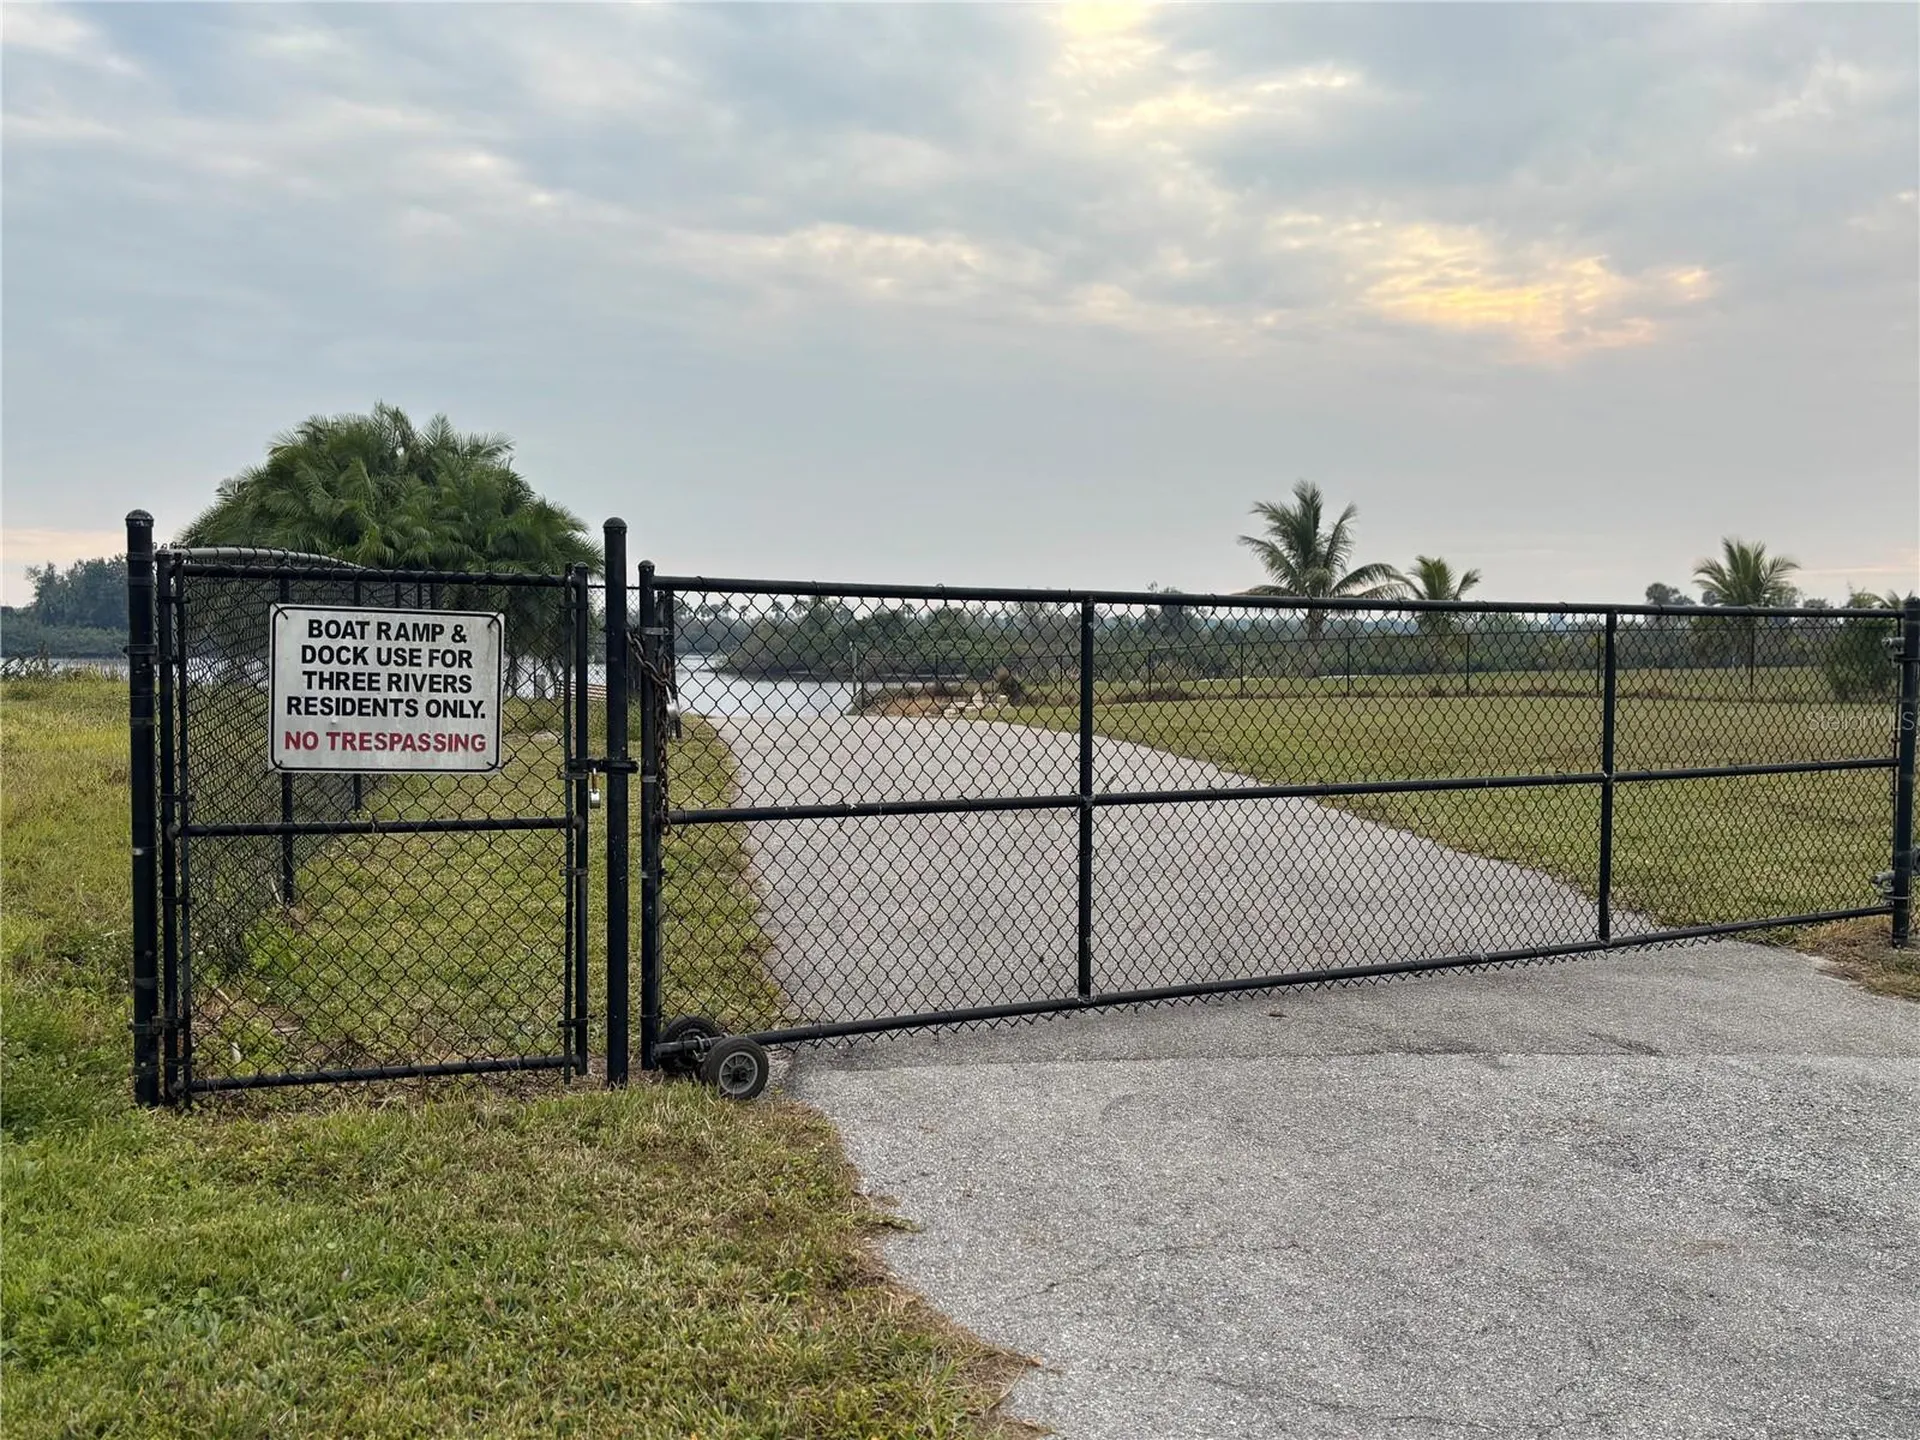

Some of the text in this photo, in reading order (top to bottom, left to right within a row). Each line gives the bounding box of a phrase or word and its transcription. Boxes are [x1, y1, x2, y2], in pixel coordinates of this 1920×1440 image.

[308, 619, 467, 643] BOAT RAMP &
[301, 645, 473, 669] DOCK USE FOR
[302, 671, 472, 694] THREE RIVERS
[286, 696, 485, 718] RESIDENTS ONLY.
[285, 731, 486, 752] NO TRESPASSING
